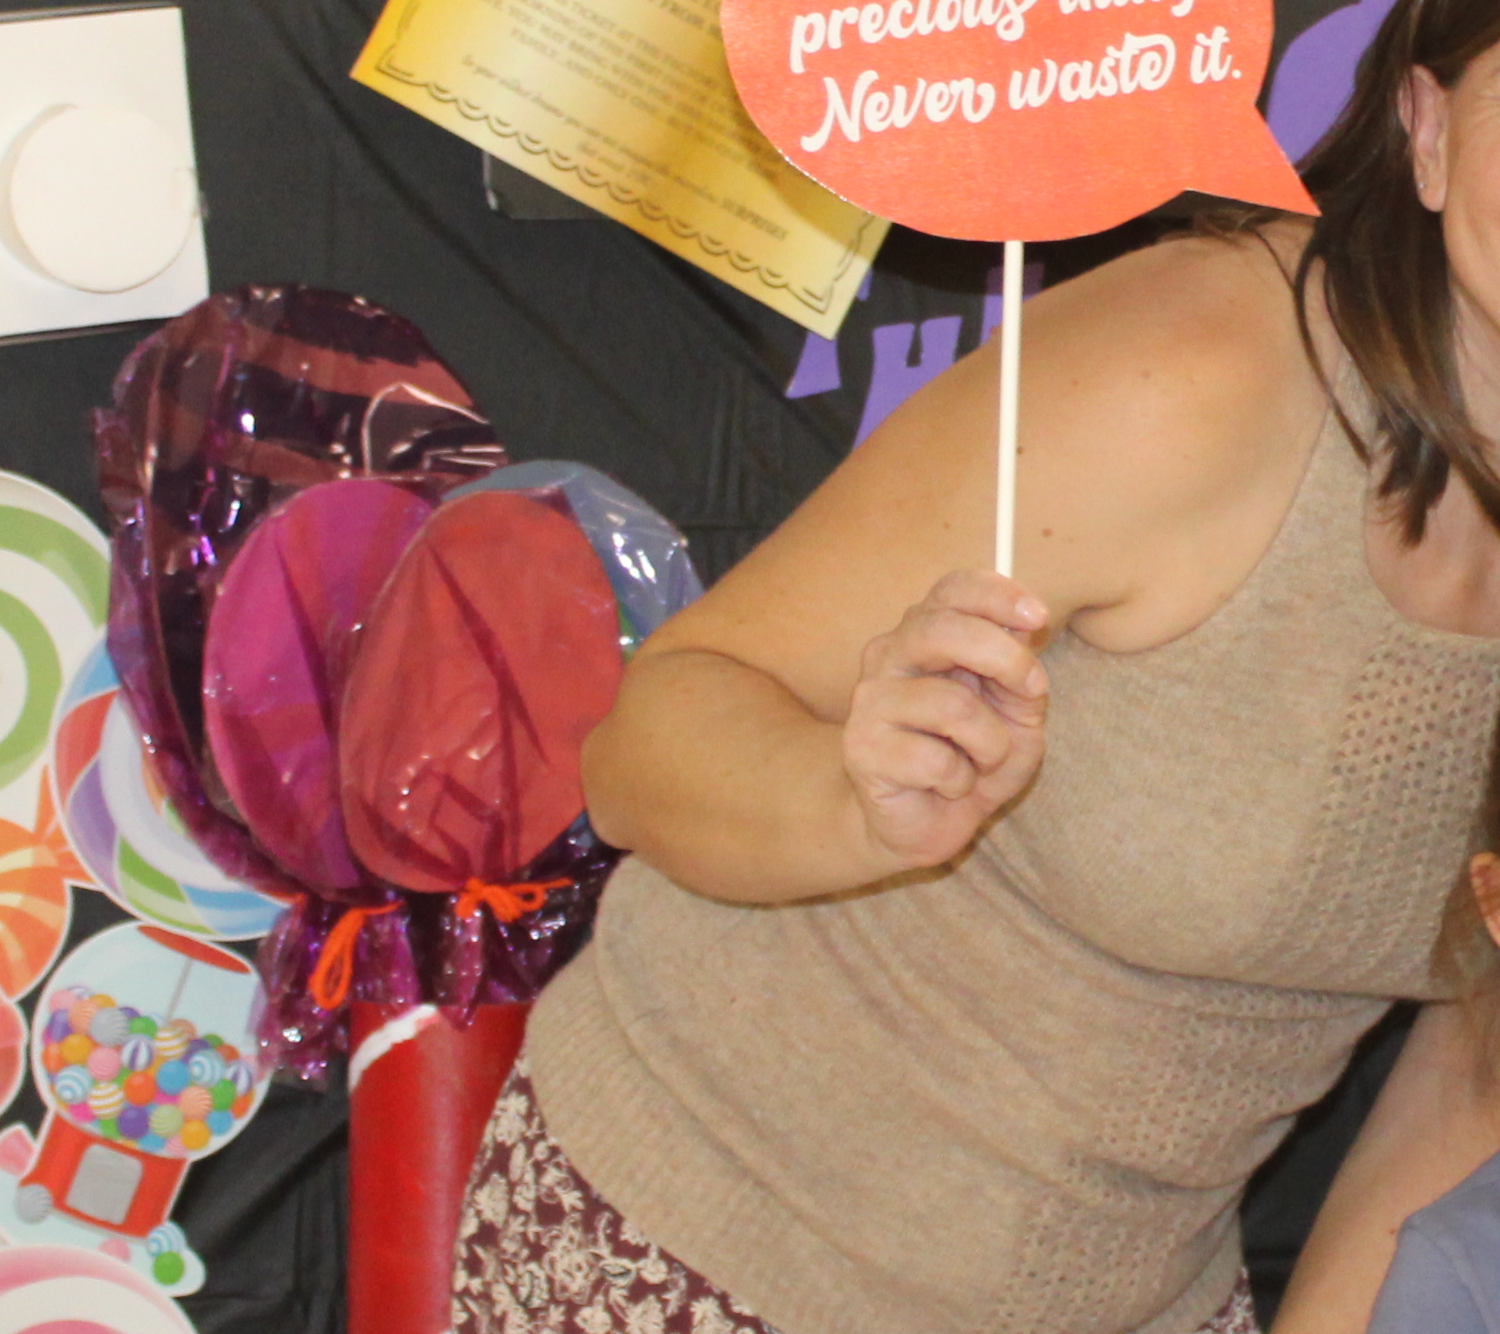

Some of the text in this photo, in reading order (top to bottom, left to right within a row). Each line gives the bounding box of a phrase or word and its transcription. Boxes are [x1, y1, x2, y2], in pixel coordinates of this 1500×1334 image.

[800, 70, 997, 153] Never
[1009, 32, 1177, 110] waste
[1189, 26, 1243, 85] it.
